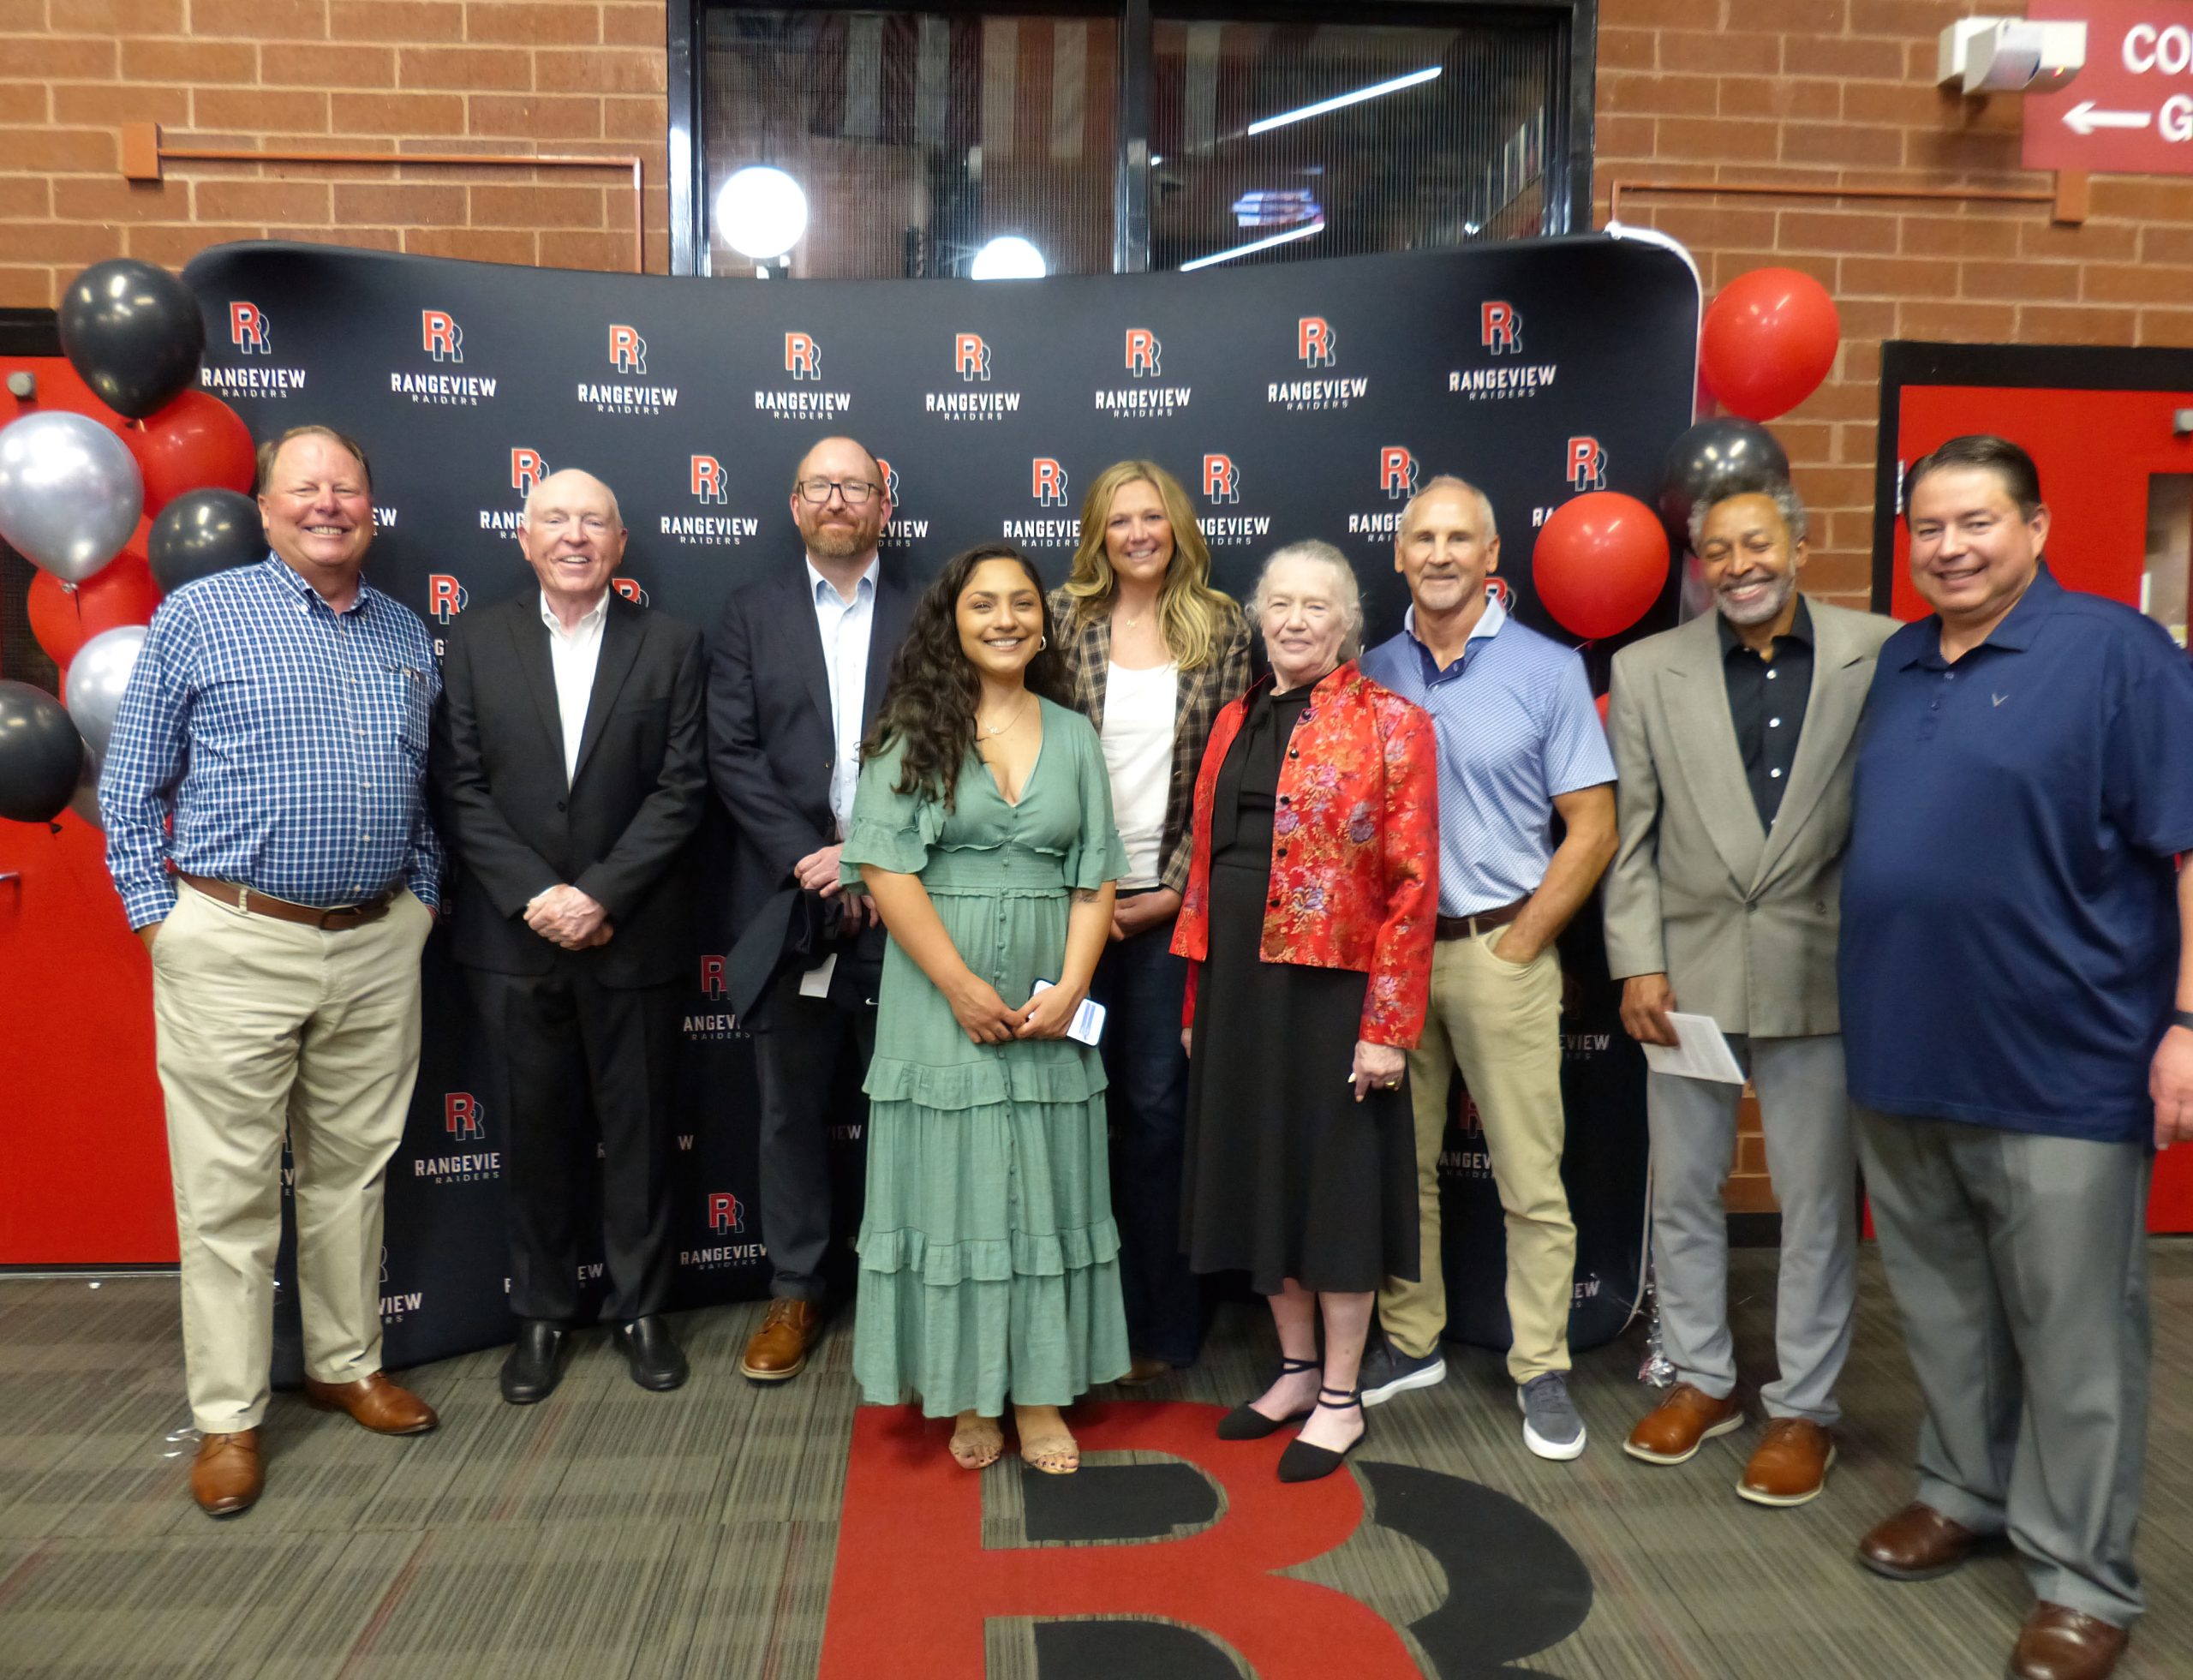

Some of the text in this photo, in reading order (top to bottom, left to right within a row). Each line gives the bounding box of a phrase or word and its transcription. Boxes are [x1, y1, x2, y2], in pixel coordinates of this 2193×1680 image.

[2122, 23, 2193, 75] CO
[201, 368, 306, 389] RANGEVIEW
[391, 373, 497, 397] RANGEVIEW
[1449, 365, 1556, 391] RANGEVIEW
[222, 389, 288, 398] RAIDERS
[578, 384, 678, 406] RANGEVIEW
[1096, 388, 1191, 410] RANGEVIEW
[1268, 378, 1368, 403] RANGEVIEW
[1469, 388, 1535, 401] RAIDERS
[412, 394, 477, 406] RAIDERS
[755, 392, 851, 411] RANGEVIEW
[926, 392, 1020, 412] RANGEVIEW
[1287, 400, 1348, 412] RAIDERS
[598, 404, 659, 415] RAIDERS
[774, 411, 834, 420] RAIDERS
[1114, 409, 1173, 418] RAIDERS
[660, 516, 758, 536] RANGEVIEW
[1003, 519, 1081, 538] RANGEVIE
[1196, 517, 1270, 535] NGEVIEW
[680, 536, 740, 546] RAIDERS
[878, 539, 911, 547] DERS
[1021, 538, 1079, 547] RAIDERS
[1204, 536, 1252, 547] IDERS
[415, 1152, 500, 1176] RANGEVIE
[435, 1171, 499, 1184] RAIDERS
